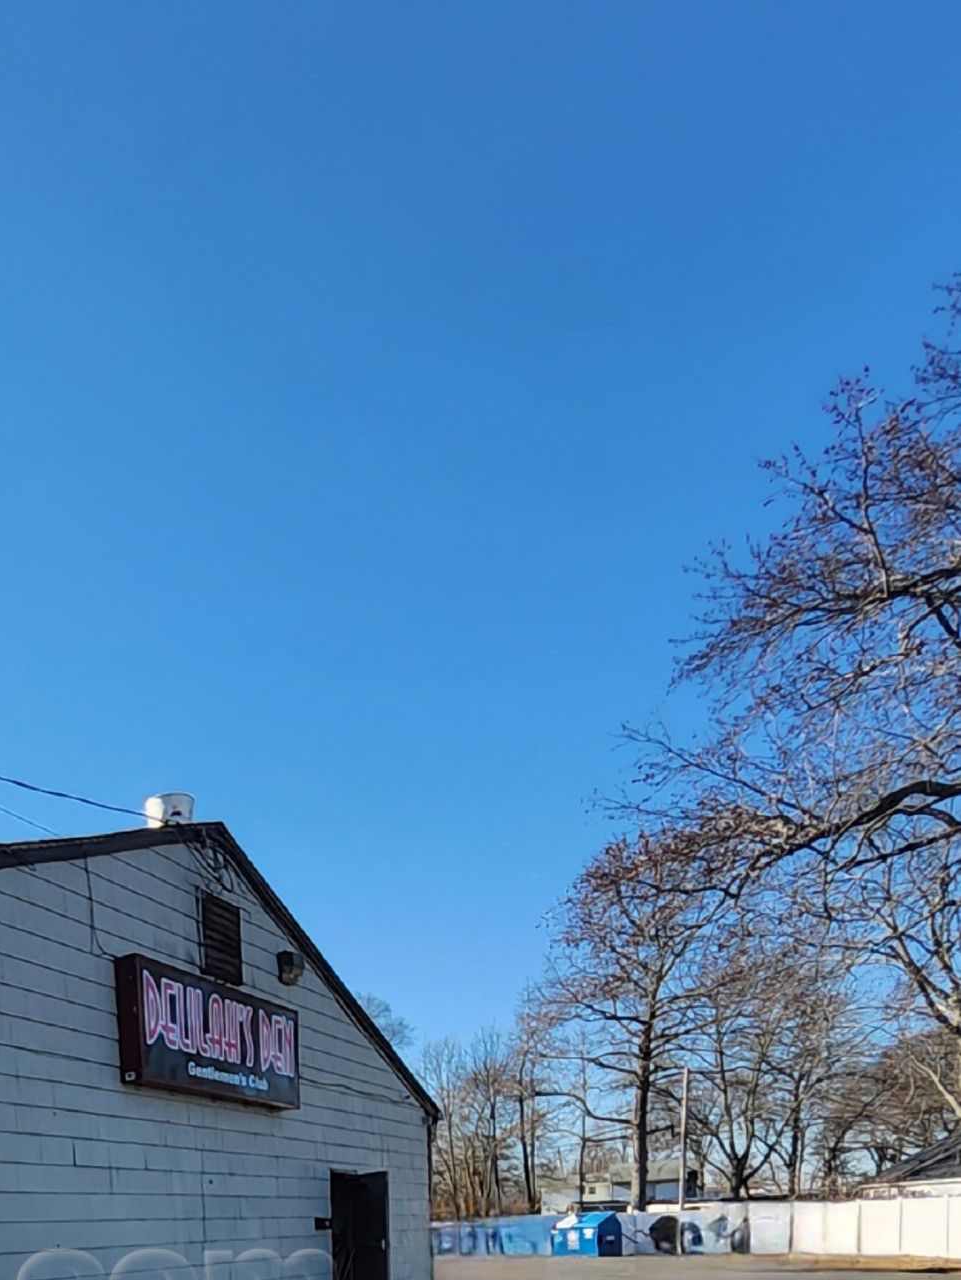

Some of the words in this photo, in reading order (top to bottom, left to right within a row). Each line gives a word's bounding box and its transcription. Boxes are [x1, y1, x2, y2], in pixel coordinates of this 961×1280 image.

[143, 969, 254, 1067] DELILAH'S
[259, 1008, 294, 1076] DEN
[188, 1061, 246, 1086] Gentlemen's
[249, 1074, 269, 1090] Club
